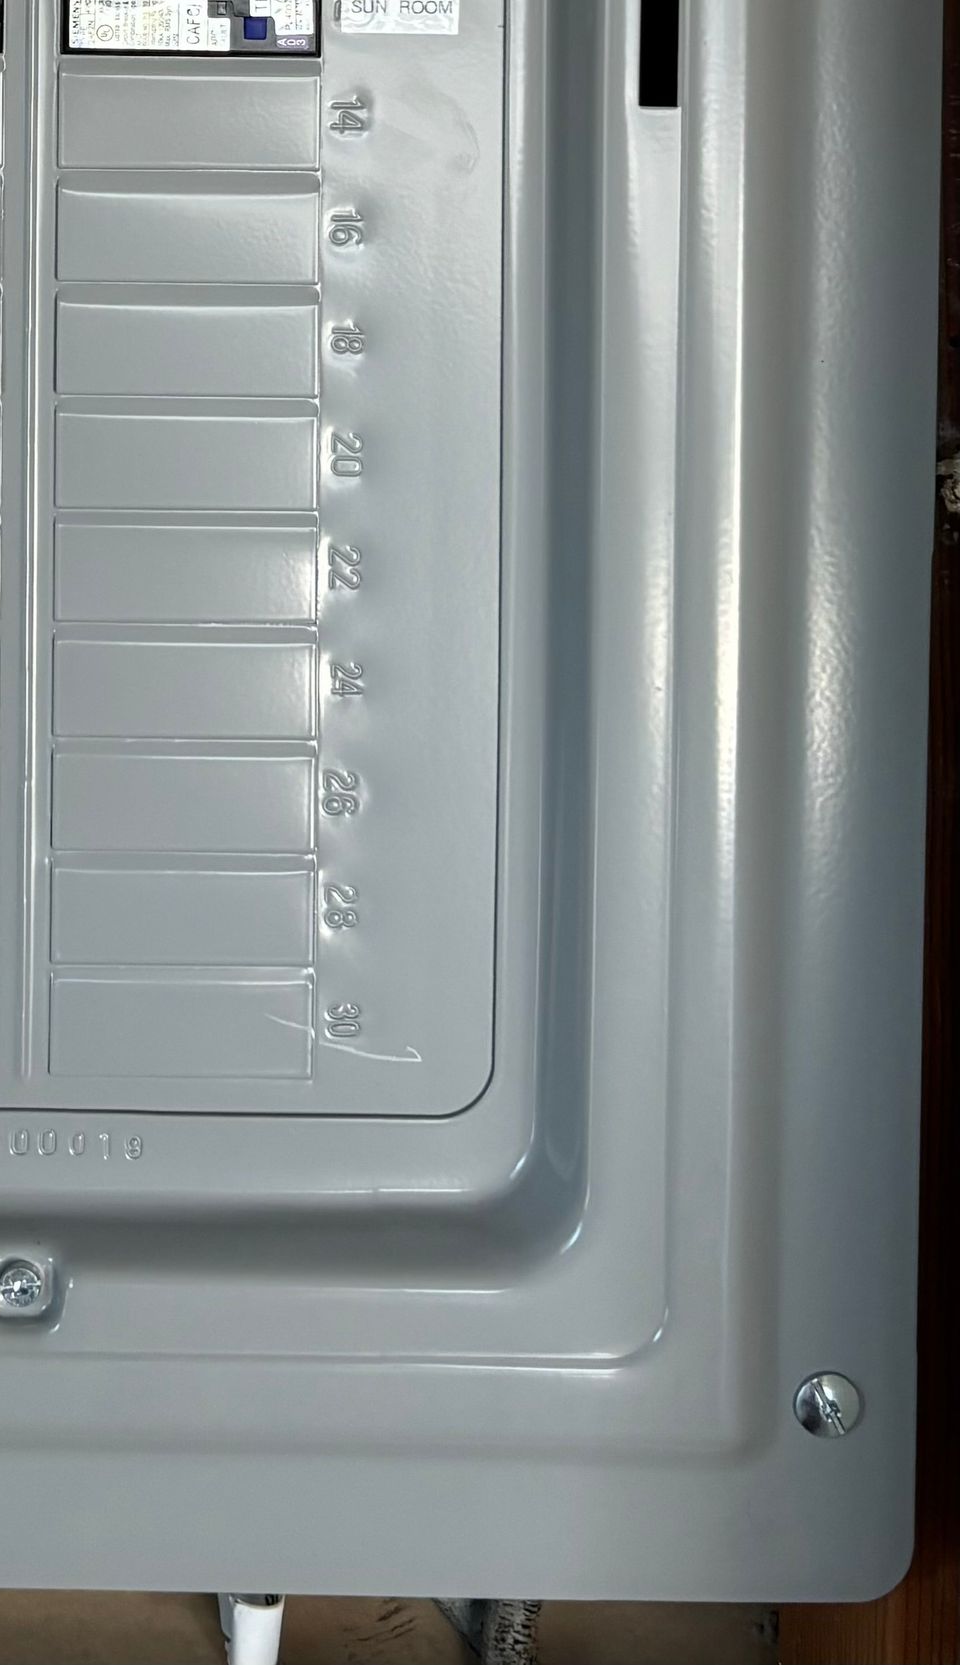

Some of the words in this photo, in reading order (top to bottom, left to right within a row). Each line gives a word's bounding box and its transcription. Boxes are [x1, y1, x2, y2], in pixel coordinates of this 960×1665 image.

[187, 4, 201, 45] CAFCI
[351, 0, 387, 14] SUN
[399, 0, 453, 14] ROOM
[329, 95, 365, 135] 14
[328, 208, 364, 247] 16
[330, 321, 366, 356] 18
[328, 430, 363, 478] 20
[328, 544, 361, 590] 22
[330, 662, 363, 699] 24
[323, 770, 359, 817] 26
[323, 884, 359, 930] 28
[324, 1003, 361, 1038] 30
